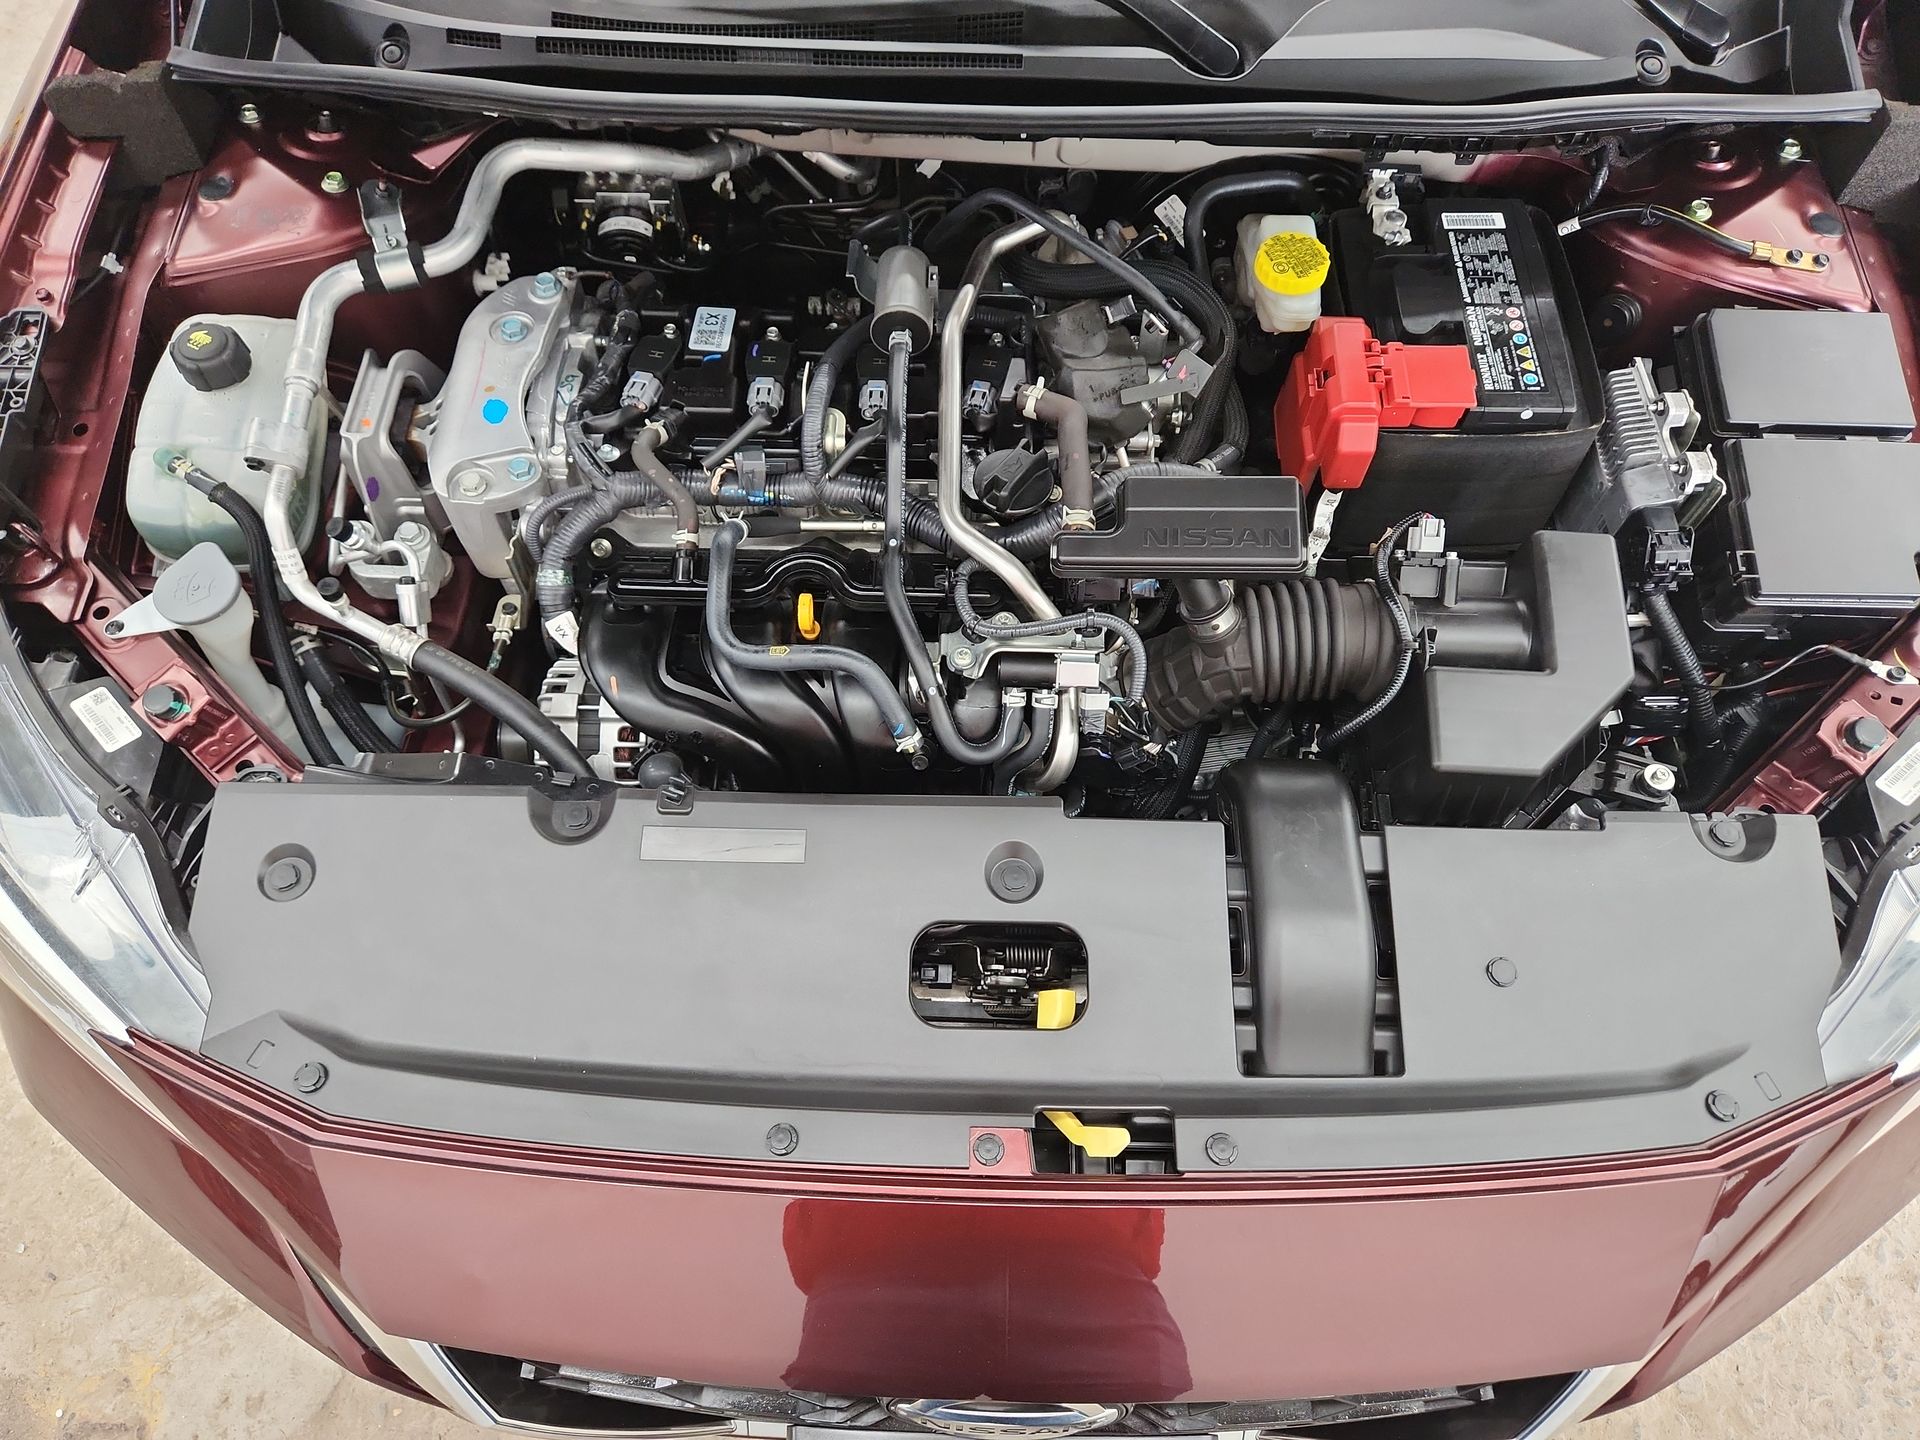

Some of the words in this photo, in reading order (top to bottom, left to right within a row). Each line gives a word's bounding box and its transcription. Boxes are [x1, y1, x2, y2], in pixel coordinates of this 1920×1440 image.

[705, 312, 721, 326] X3
[1465, 306, 1483, 346] NISSAN
[1477, 352, 1494, 391] RENAULT
[1143, 526, 1292, 549] NISSAN
[554, 624, 569, 639] XA
[920, 1417, 1094, 1436] NISSAN
